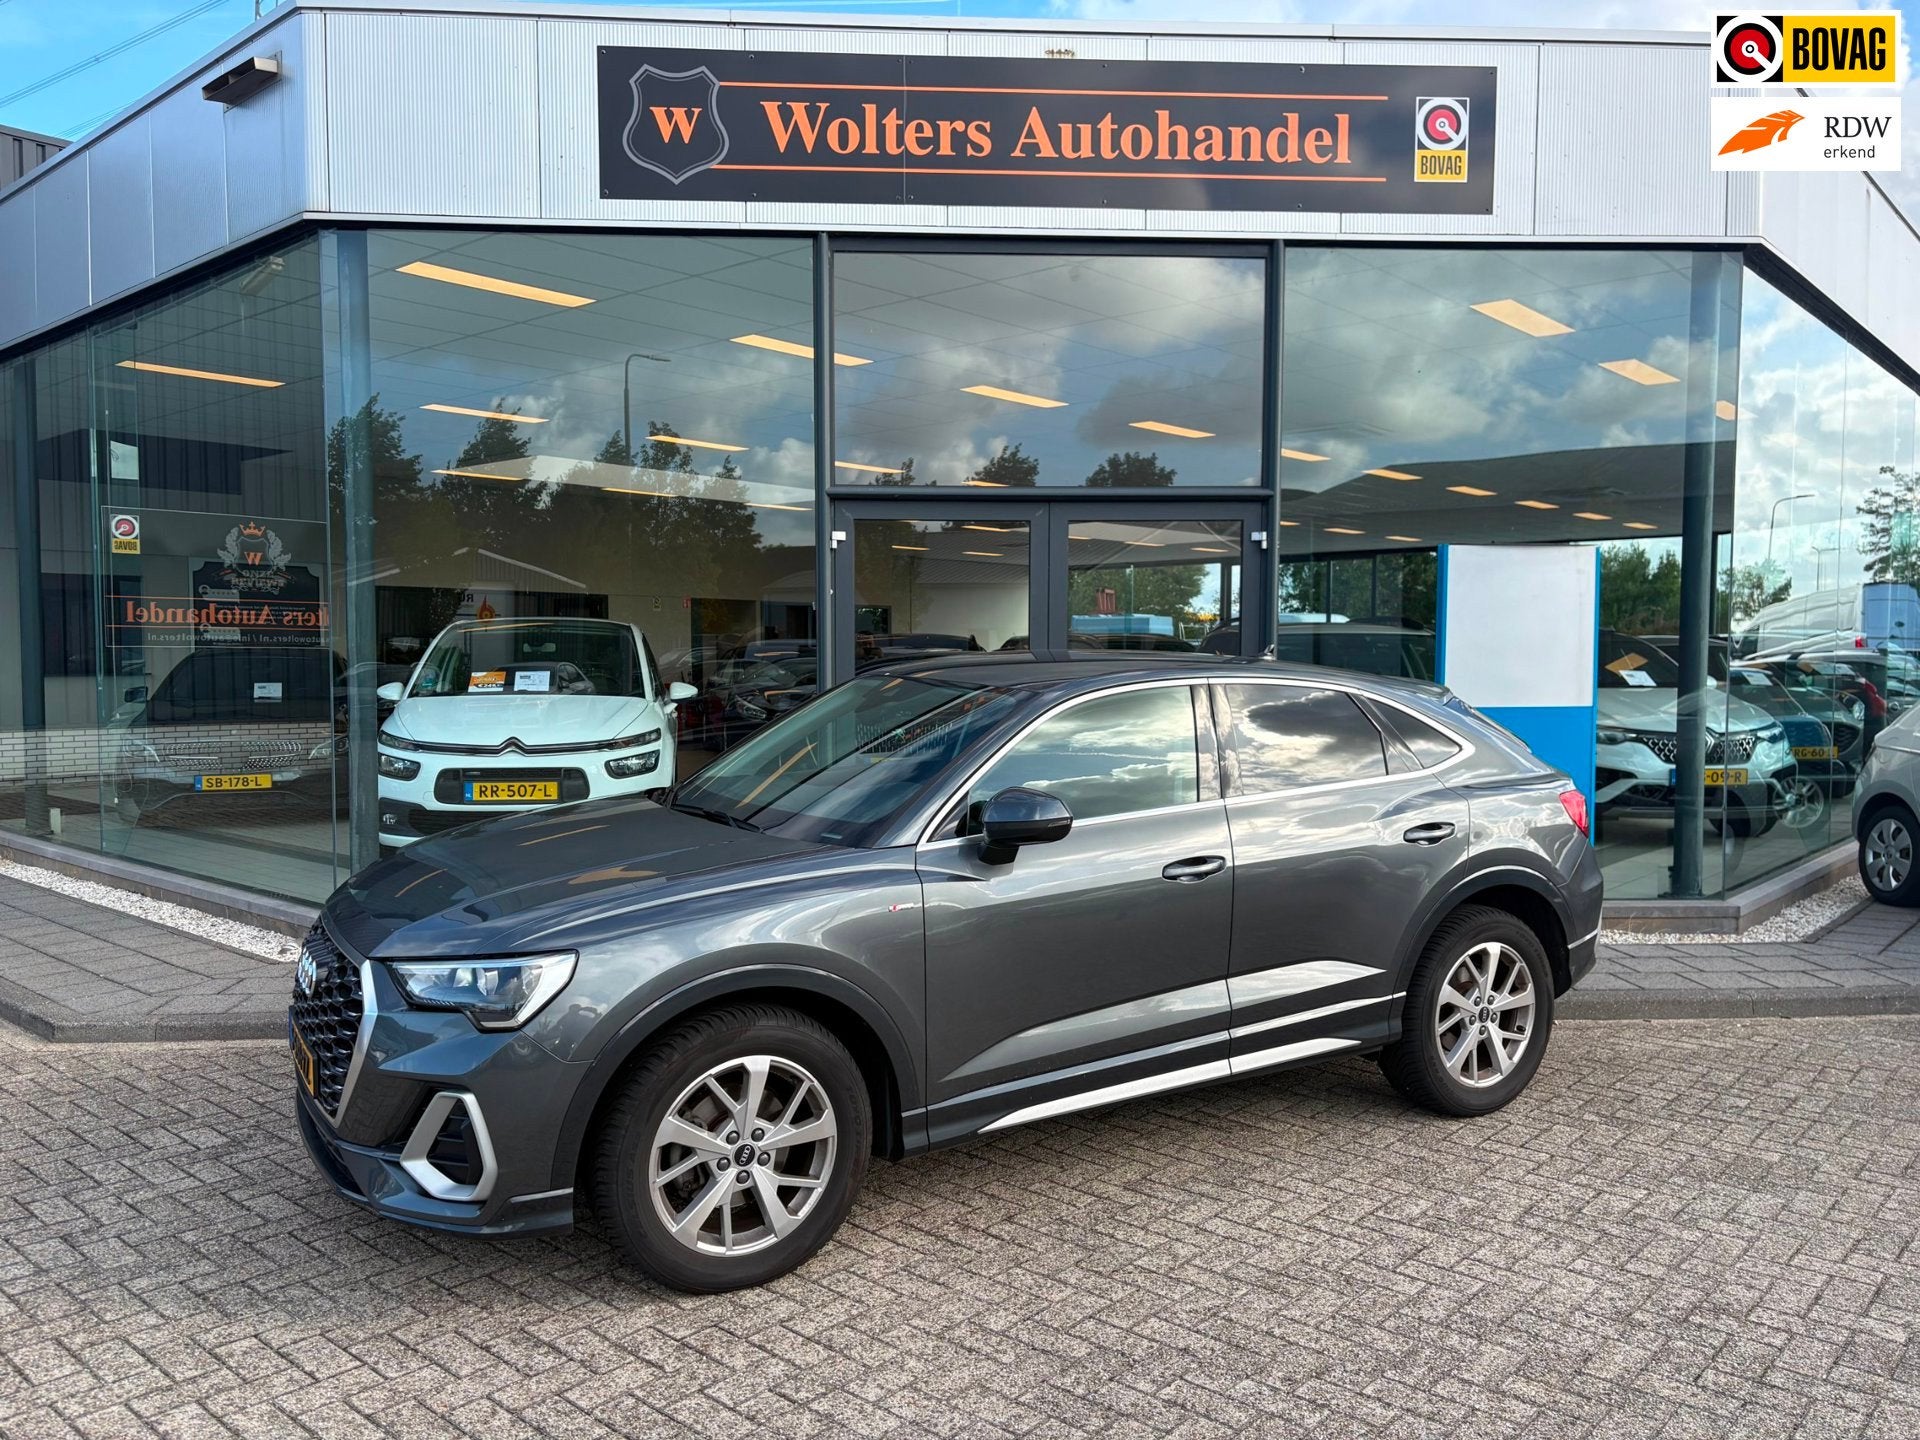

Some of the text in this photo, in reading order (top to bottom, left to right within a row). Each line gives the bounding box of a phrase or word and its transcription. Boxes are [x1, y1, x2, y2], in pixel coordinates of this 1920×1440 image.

[649, 106, 703, 145] W
[759, 100, 1352, 165] Wolters Autohandel
[1420, 153, 1463, 176] BOVAG
[205, 776, 262, 788] SB-178-L
[478, 784, 552, 798] RR-507-L
